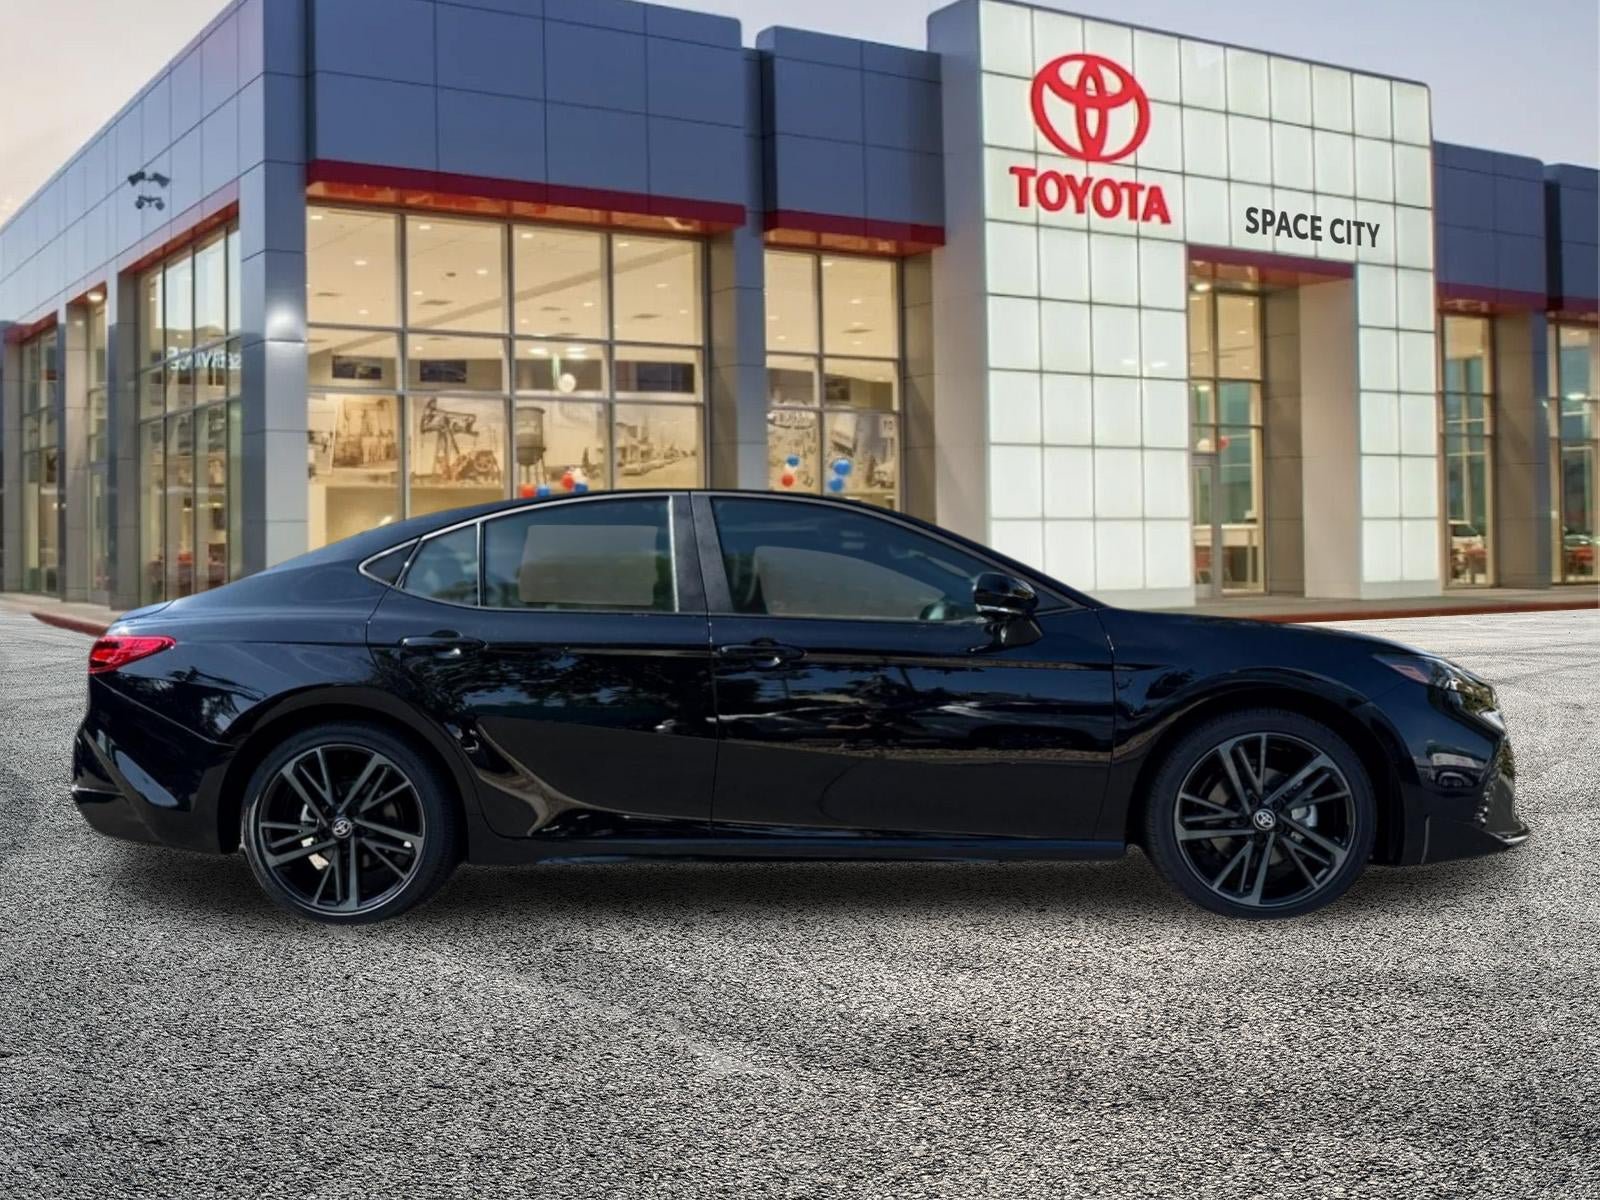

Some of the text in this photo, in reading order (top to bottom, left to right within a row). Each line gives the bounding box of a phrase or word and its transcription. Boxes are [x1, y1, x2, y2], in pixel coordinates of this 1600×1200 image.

[1010, 166, 1171, 225] TOYOTA
[1245, 206, 1380, 248] SPACE CITY
